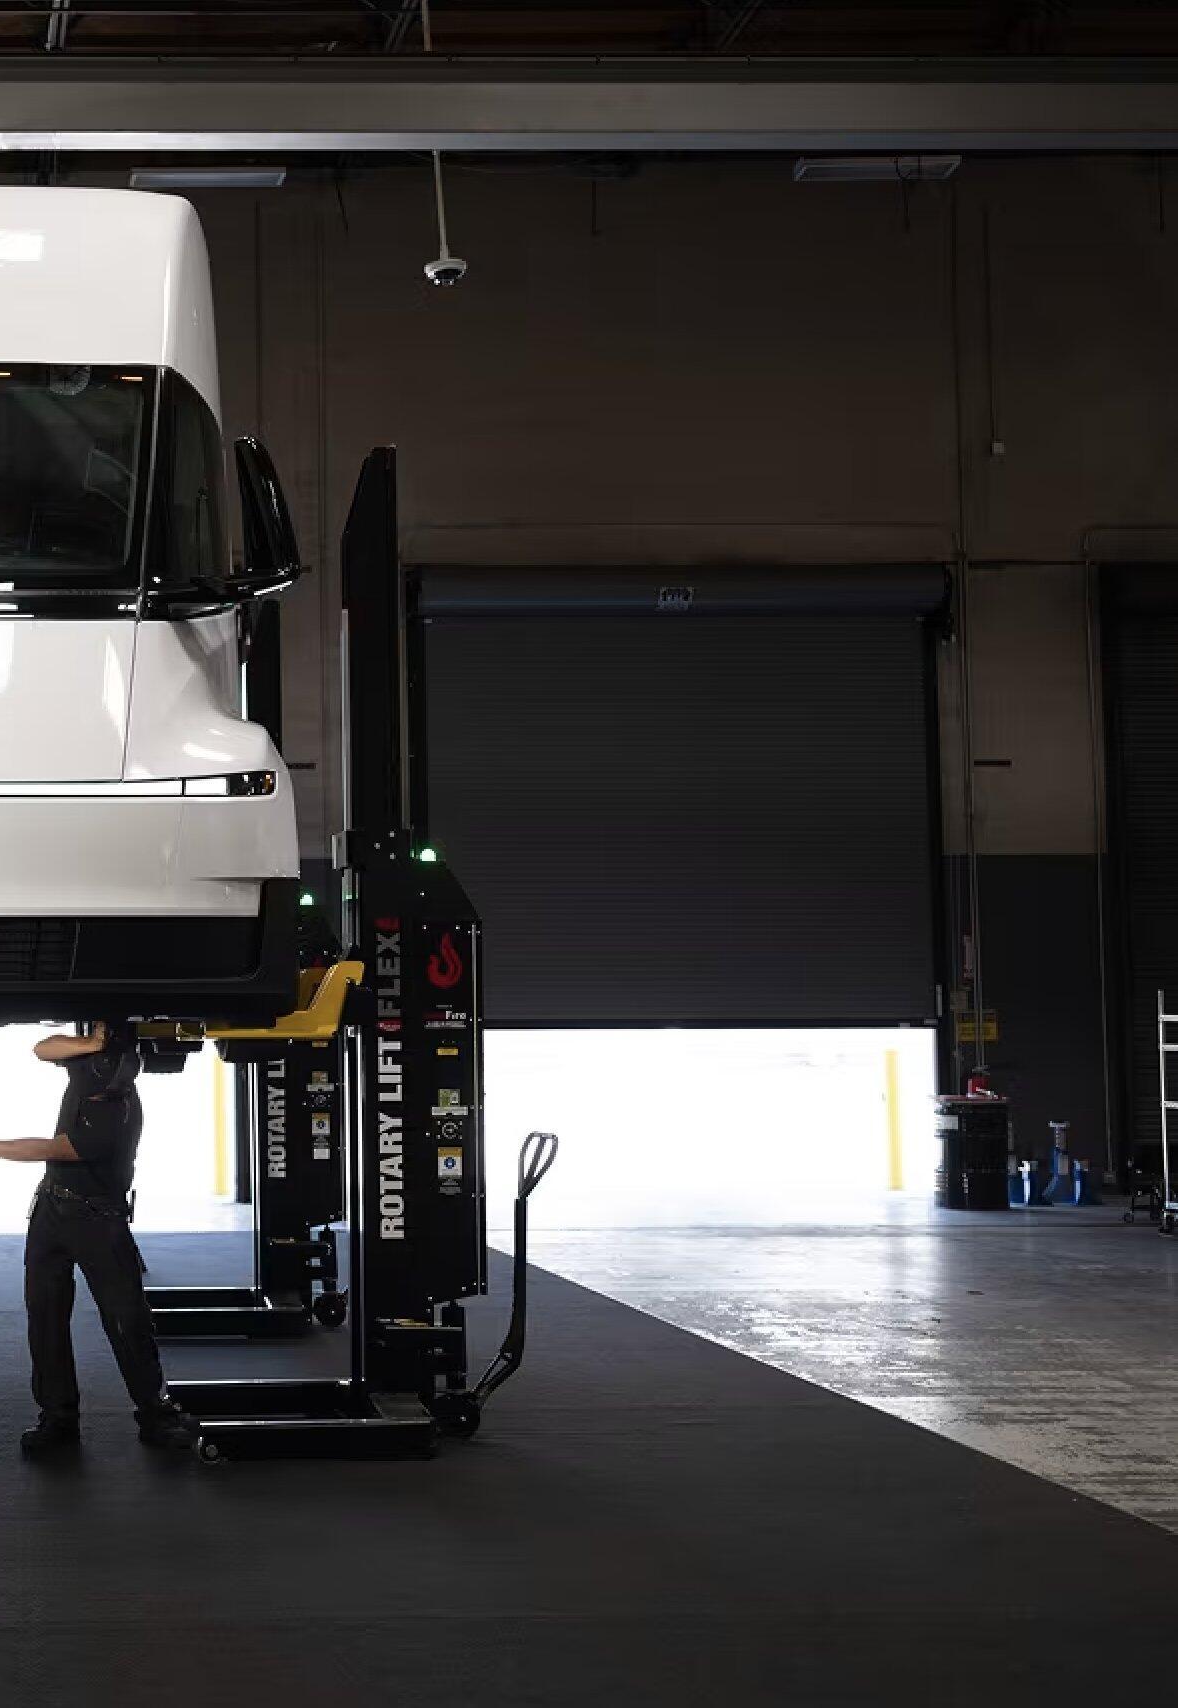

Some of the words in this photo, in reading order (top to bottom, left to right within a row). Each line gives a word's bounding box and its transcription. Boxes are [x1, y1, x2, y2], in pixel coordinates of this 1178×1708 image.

[375, 932, 402, 1017] FLEX
[376, 1036, 403, 1102] LIFT
[267, 1084, 287, 1178] ROTARY
[377, 1112, 405, 1240] ROTARY
